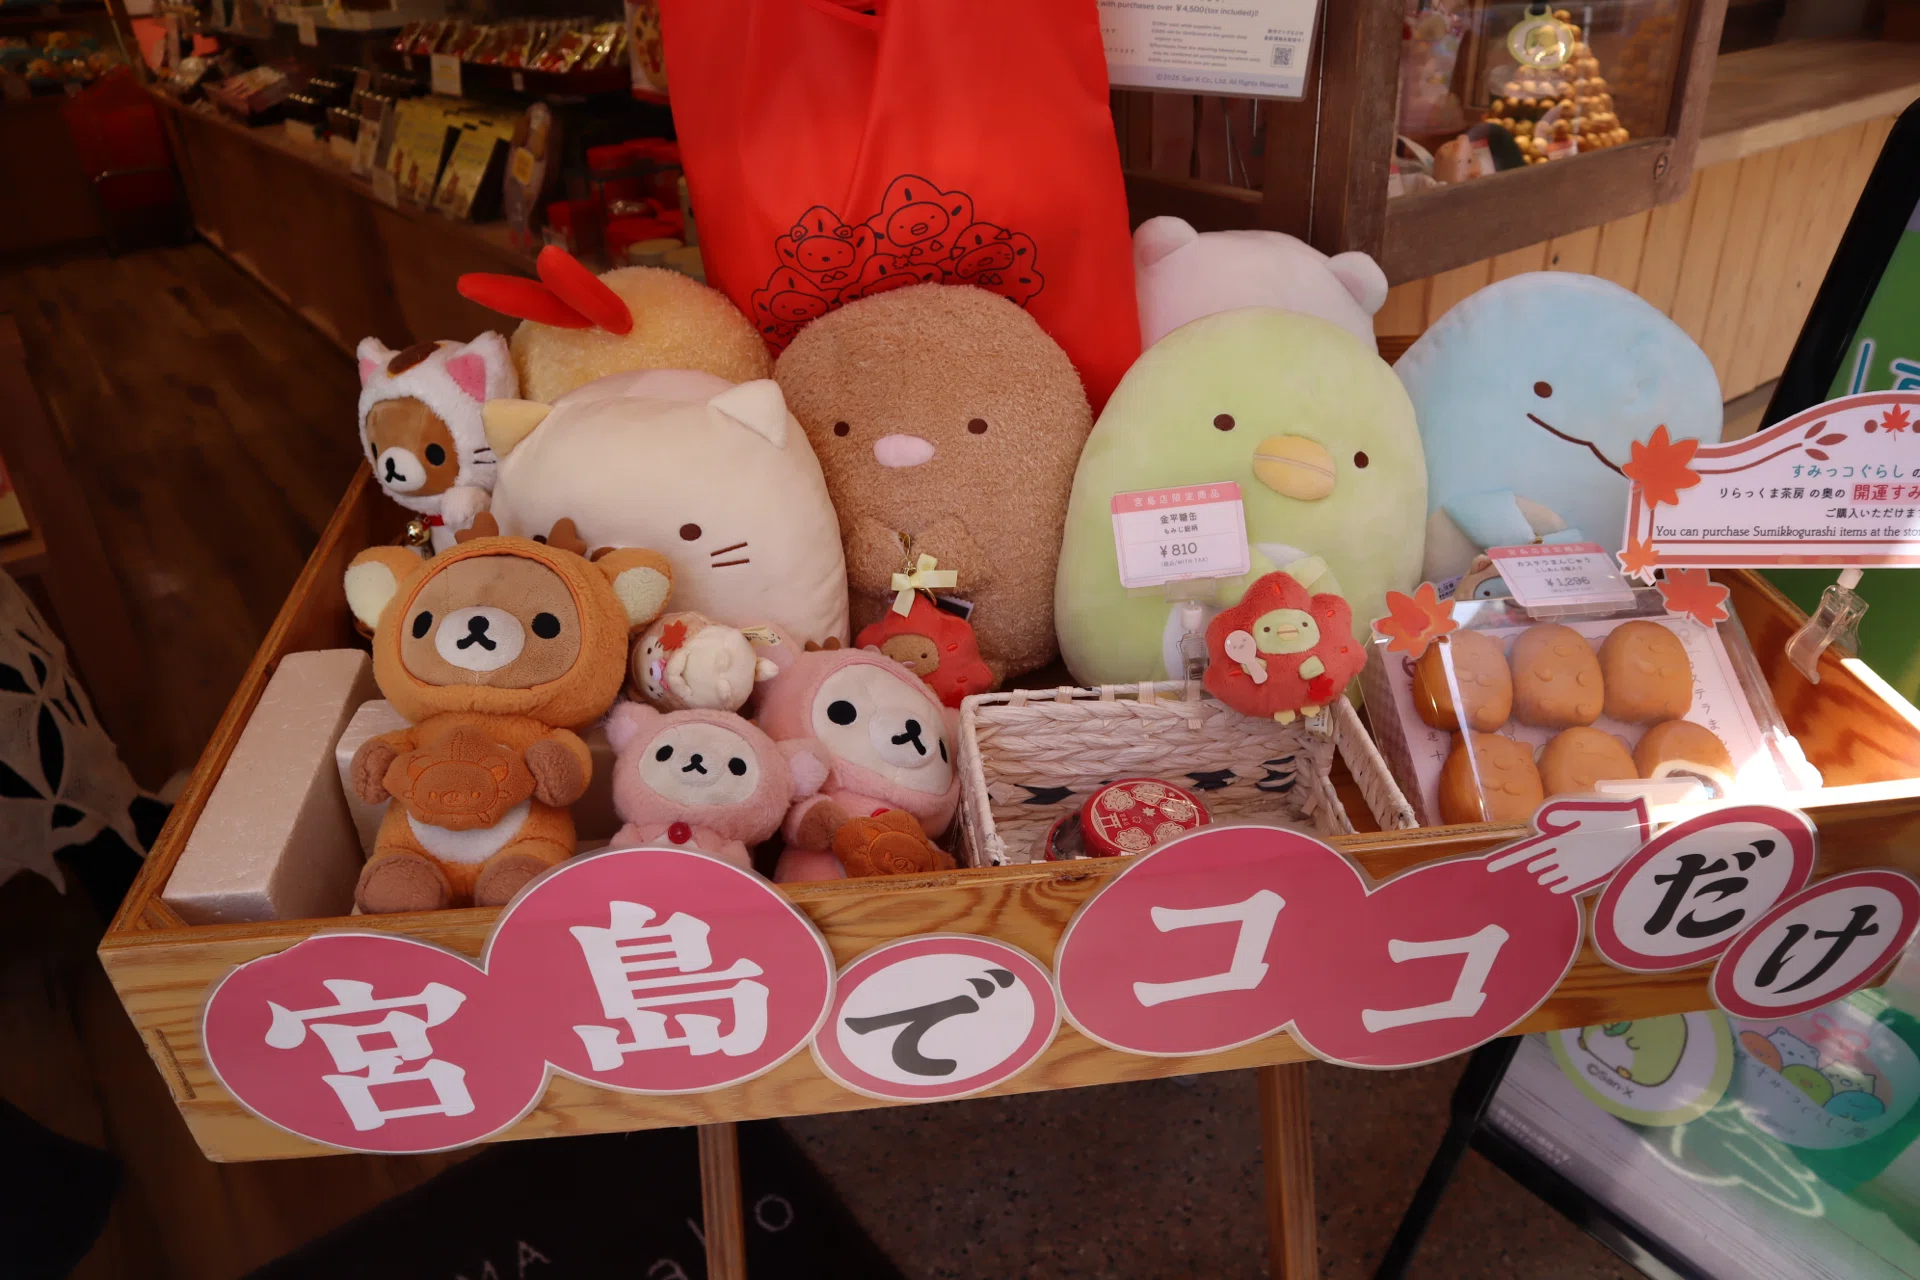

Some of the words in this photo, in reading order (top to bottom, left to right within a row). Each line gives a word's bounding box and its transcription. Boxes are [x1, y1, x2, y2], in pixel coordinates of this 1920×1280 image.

[1118, 2, 1155, 11] purchases
[1792, 464, 1904, 478] すみっコぐらし
[1656, 526, 1676, 537] You
[1680, 527, 1699, 537] can
[1703, 526, 1750, 539] purchase
[1753, 525, 1837, 539] Sumikkogurashi
[1840, 526, 1867, 537] items
[1870, 527, 1880, 537] at
[1884, 526, 1900, 537] the
